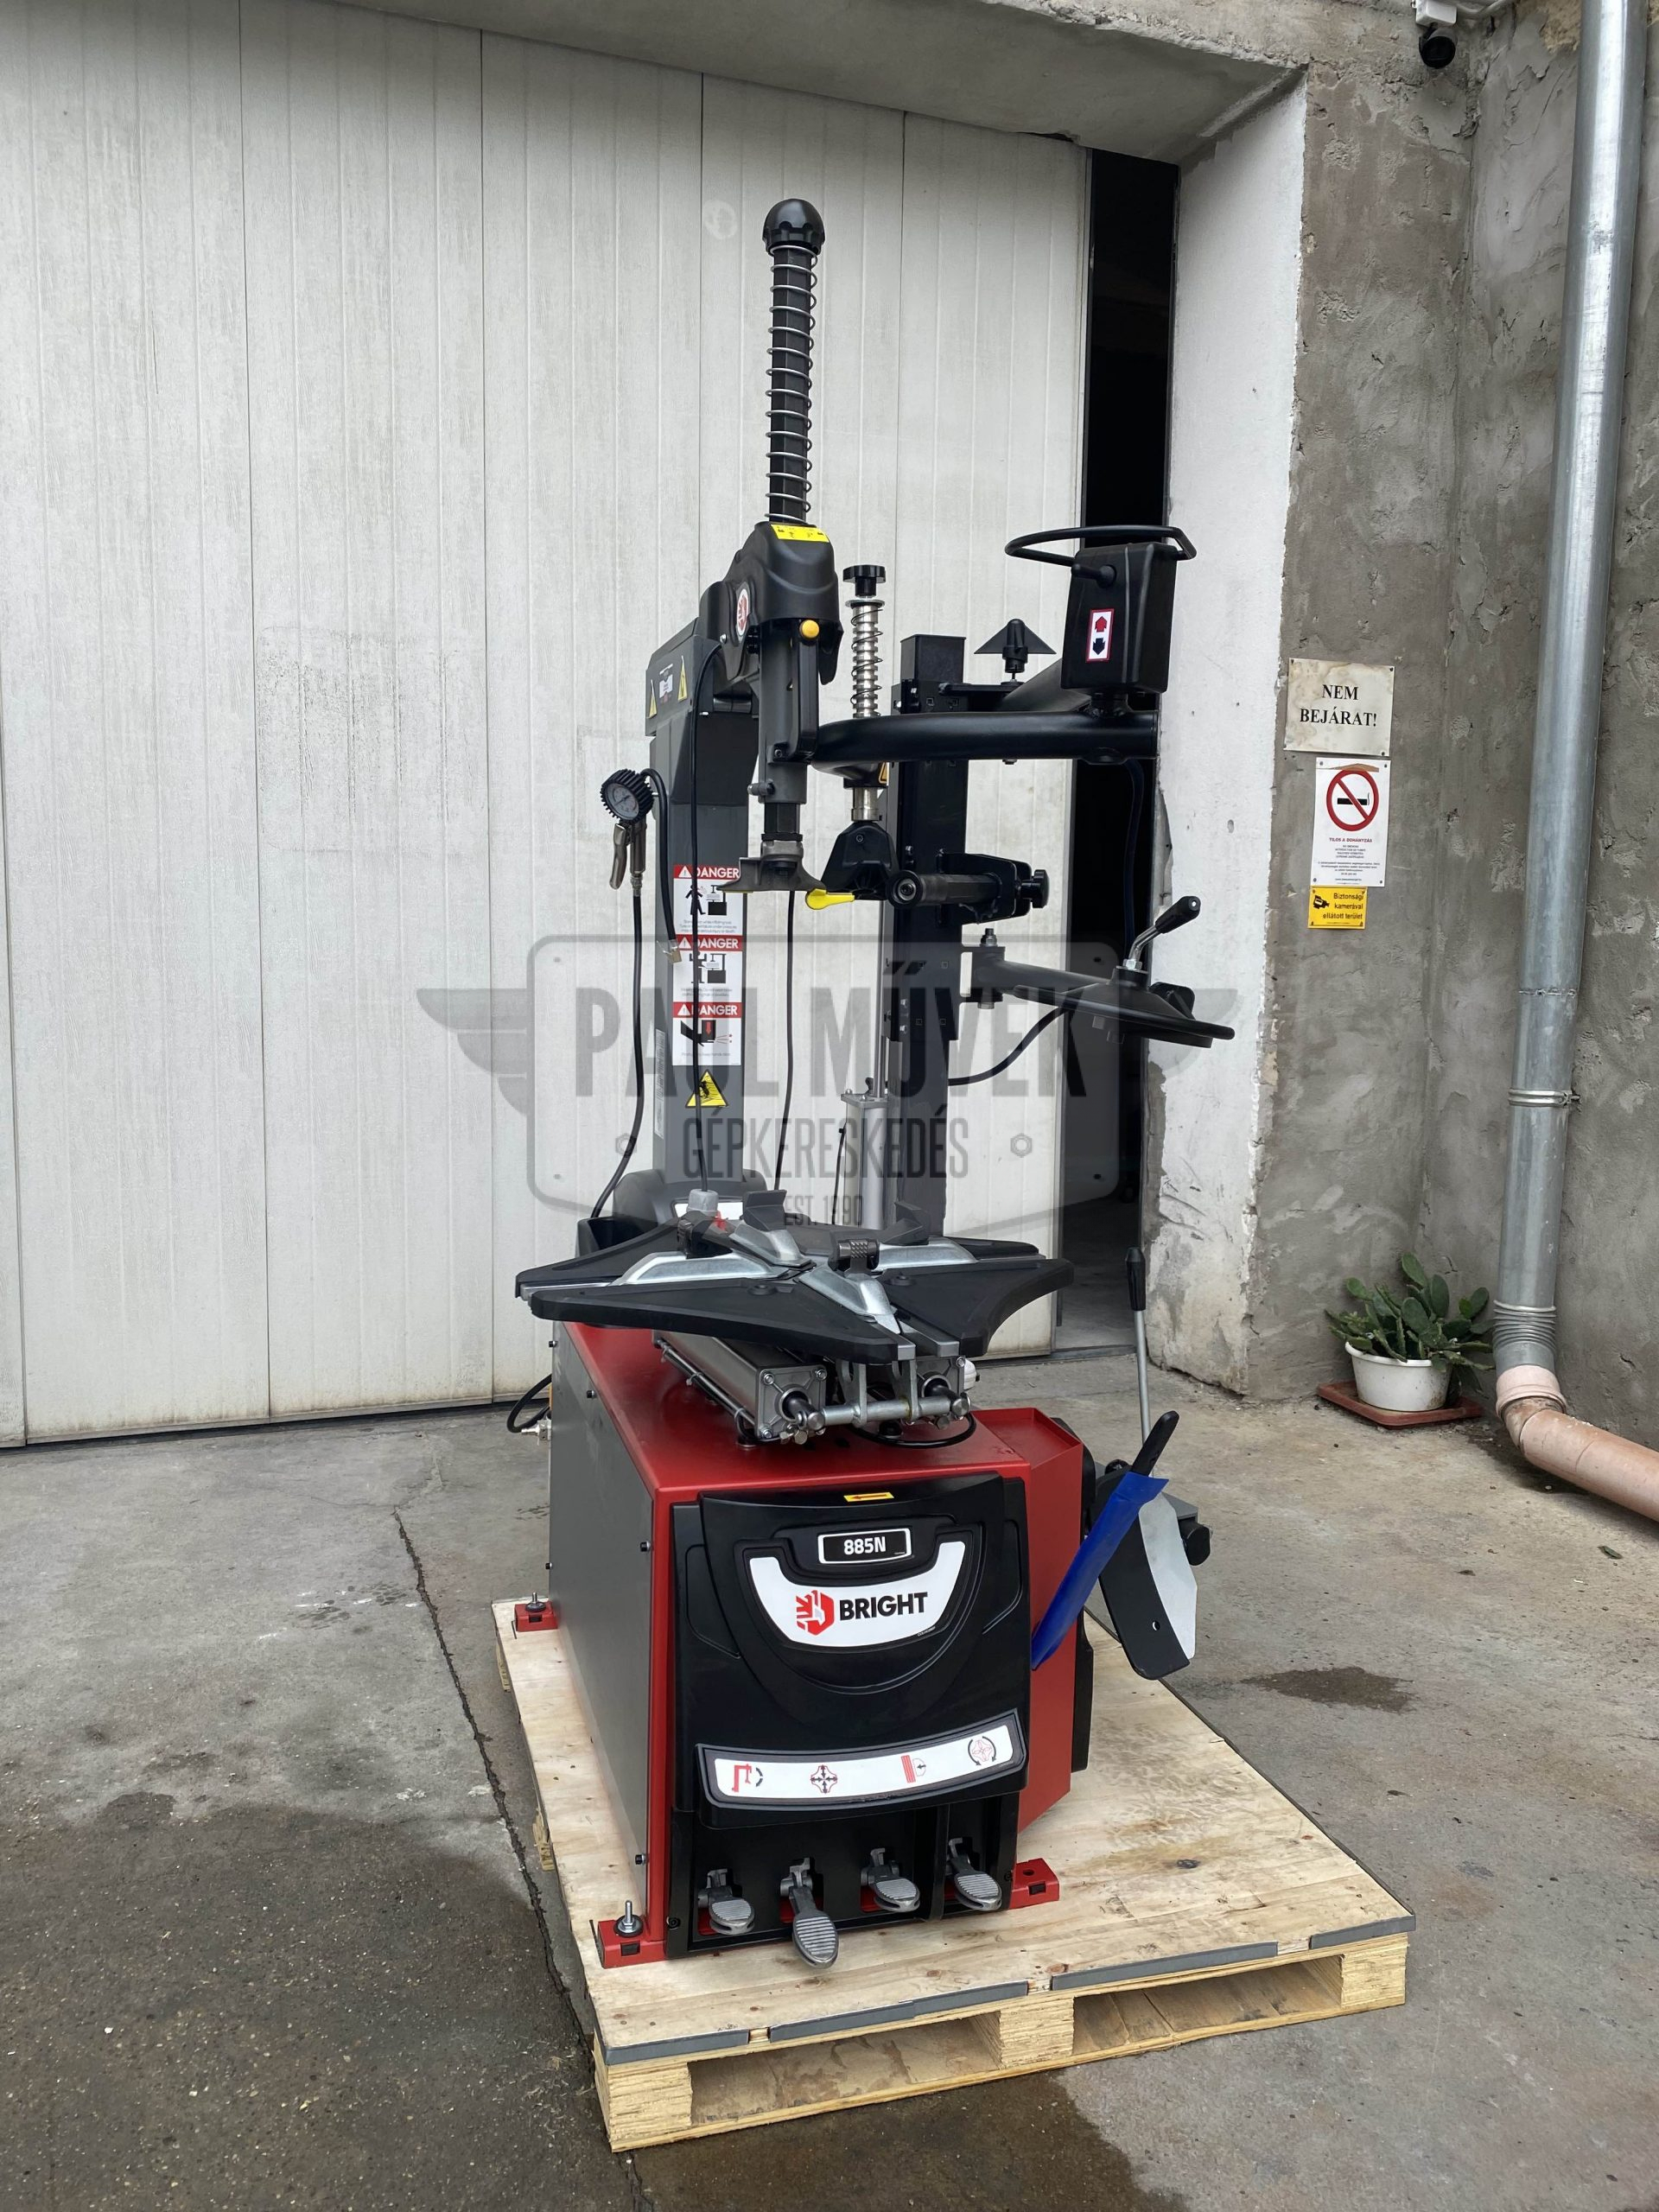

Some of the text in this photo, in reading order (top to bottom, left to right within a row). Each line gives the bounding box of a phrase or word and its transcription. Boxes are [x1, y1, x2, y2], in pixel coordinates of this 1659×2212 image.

[1322, 684, 1359, 701] NEM
[1300, 706, 1377, 728] BEJÁRAT!
[1333, 893, 1364, 901] Biztonsági
[696, 938, 739, 949] ANGER
[843, 1536, 887, 1555] 885N
[839, 1592, 929, 1621] BRIGHT
